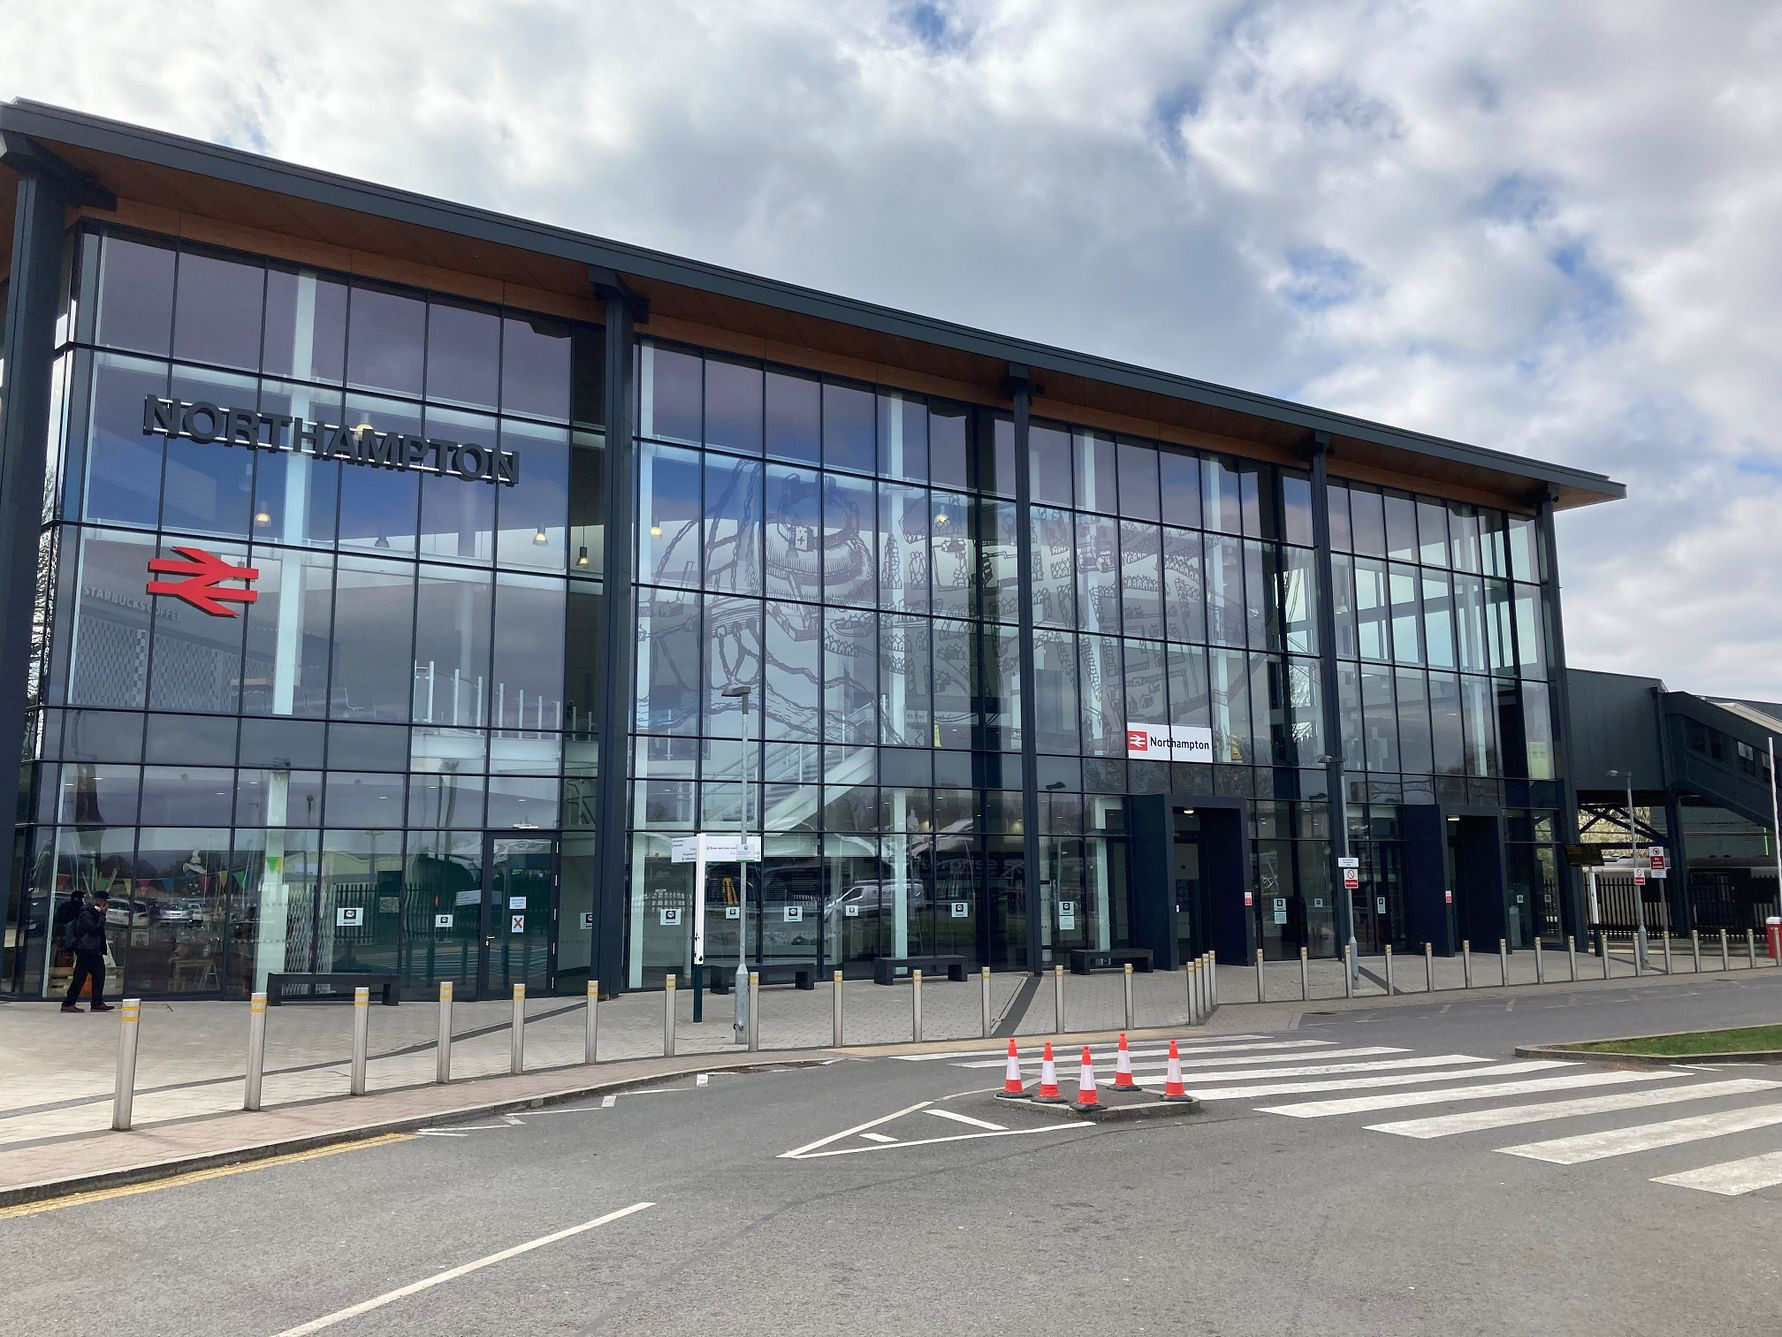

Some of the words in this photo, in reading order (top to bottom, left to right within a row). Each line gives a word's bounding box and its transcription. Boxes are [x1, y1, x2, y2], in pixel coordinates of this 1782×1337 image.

[143, 394, 520, 486] NORTHAMPTON
[82, 584, 146, 612] STARBUCKS
[1150, 736, 1210, 751] Northampton
